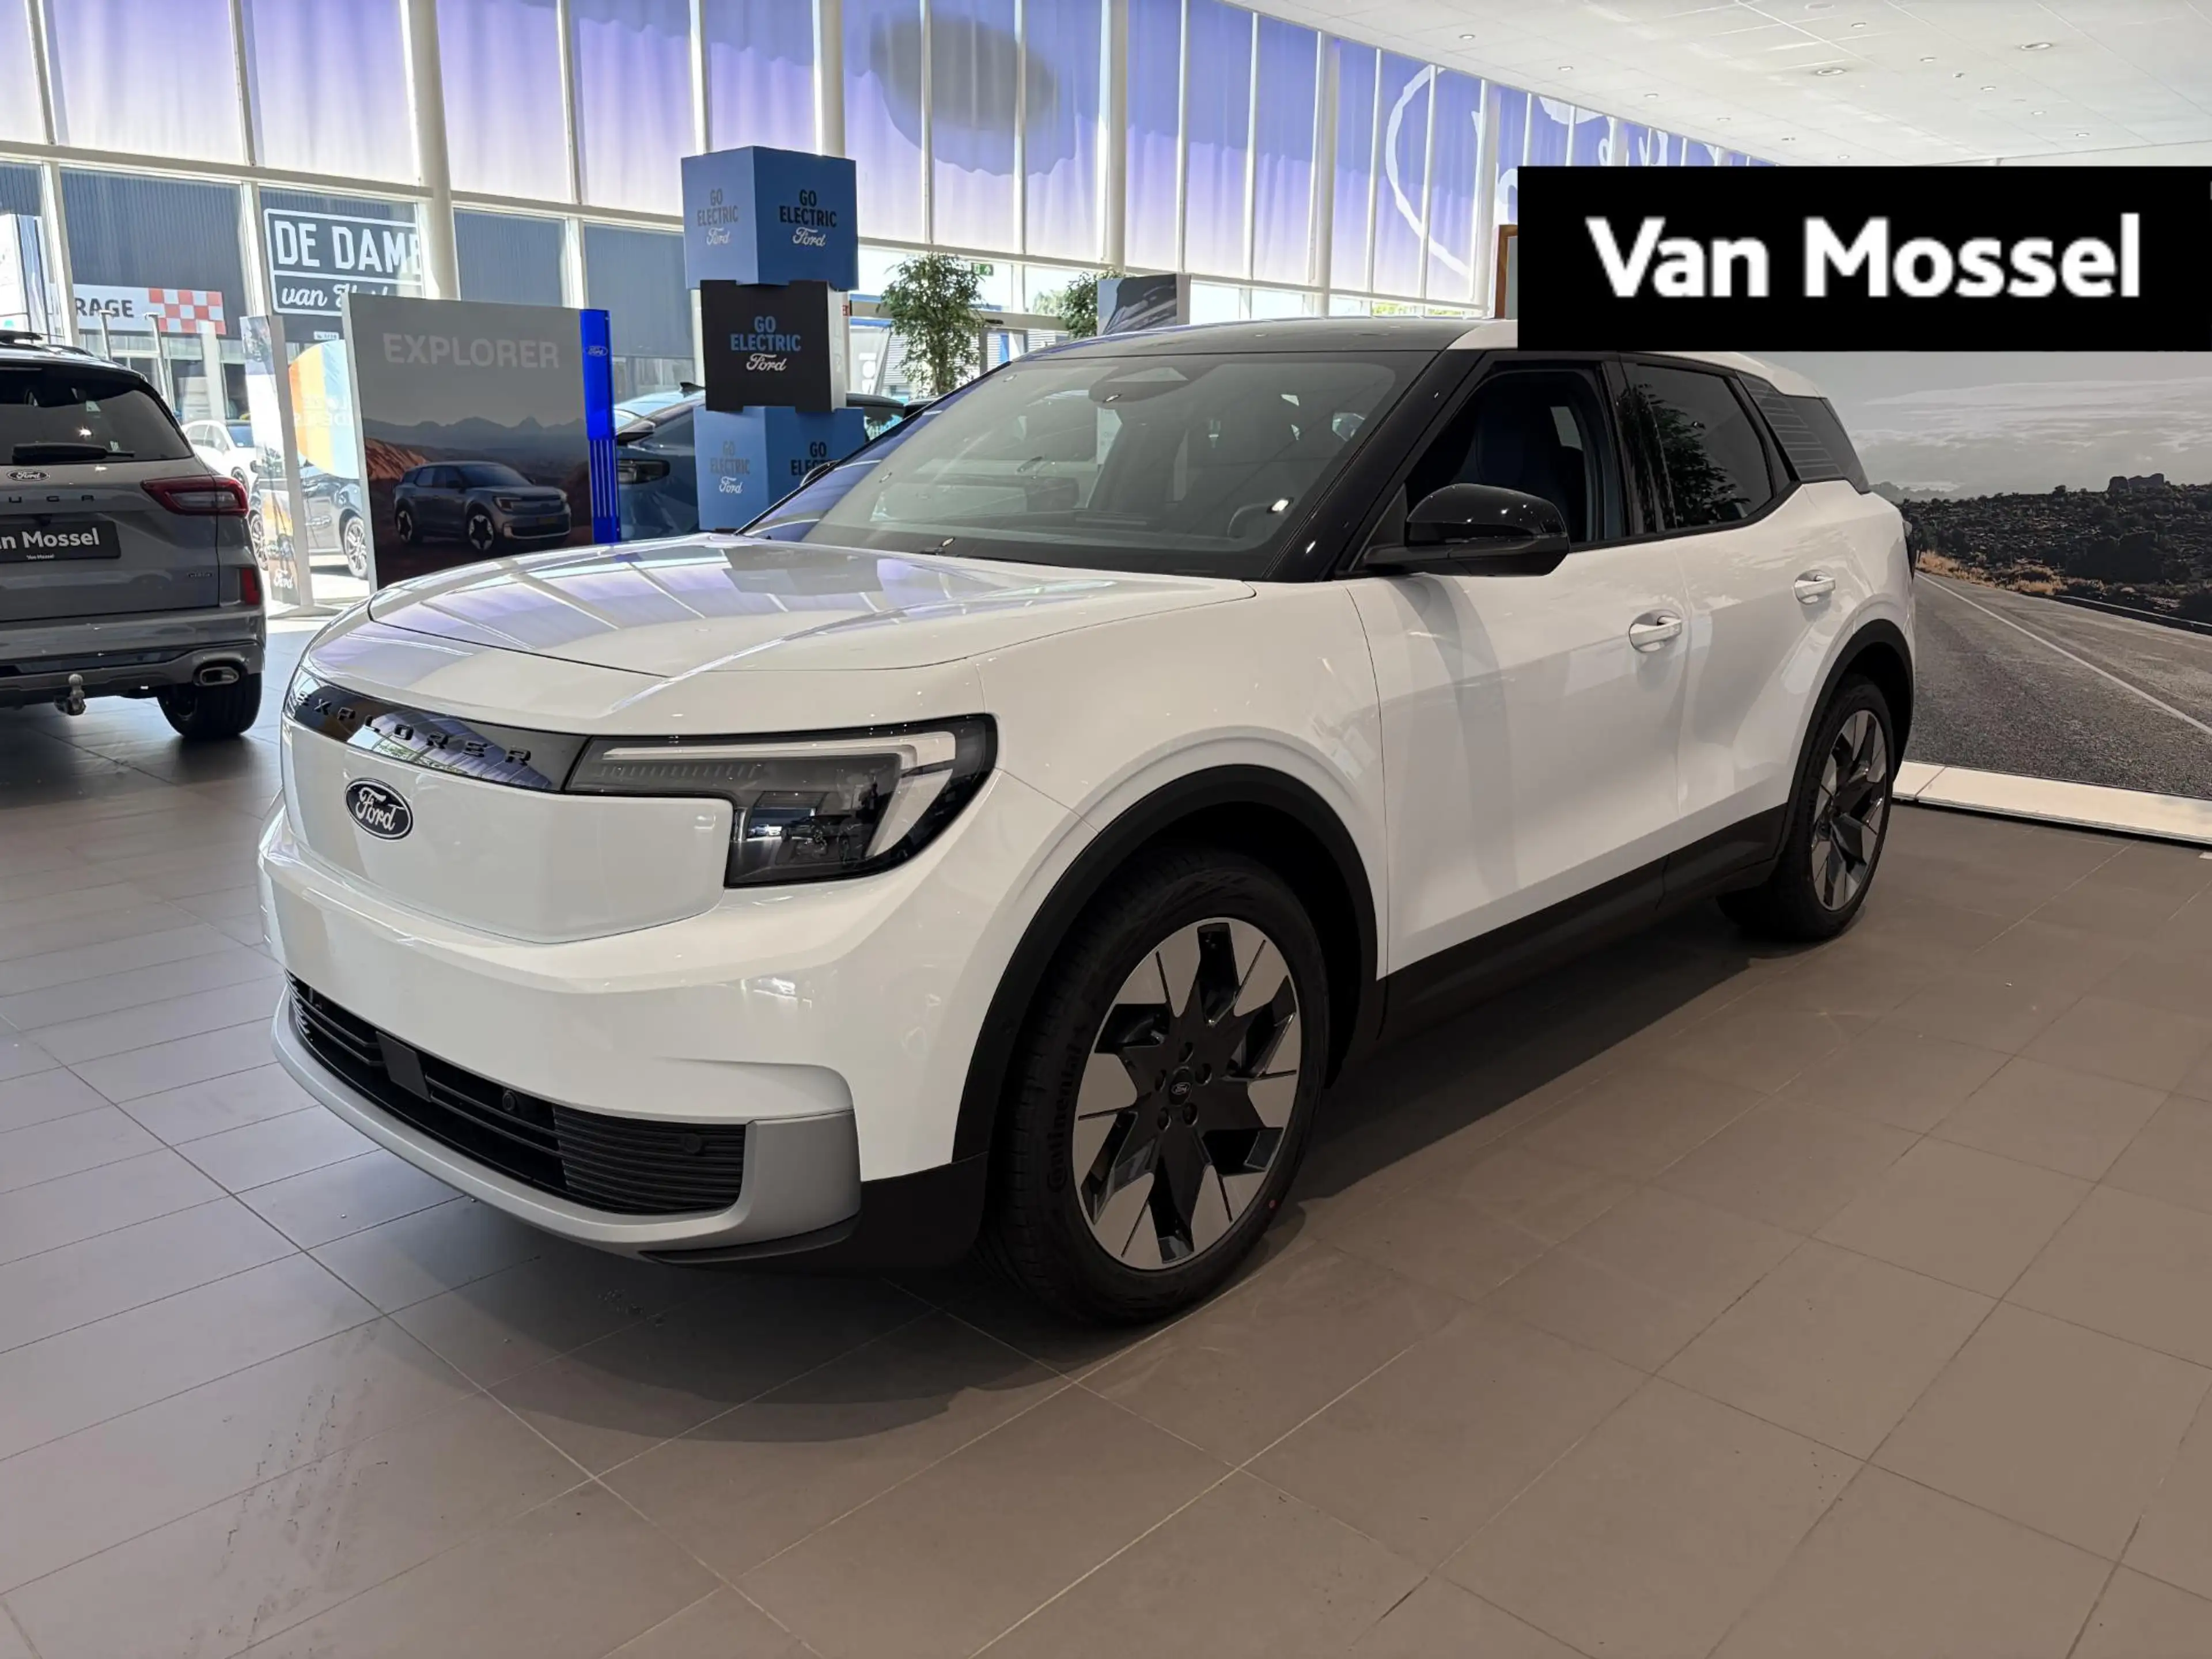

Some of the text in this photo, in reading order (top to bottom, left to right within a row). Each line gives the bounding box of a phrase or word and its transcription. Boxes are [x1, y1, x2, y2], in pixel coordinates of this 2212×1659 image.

[710, 188, 723, 206] GO
[800, 189, 817, 207] GO
[697, 205, 738, 227] ELECTRIC
[779, 205, 837, 228] ELECTRIC
[274, 219, 320, 268] DE
[706, 227, 730, 245] Ford
[793, 226, 827, 247] Ford
[282, 287, 328, 307] van
[754, 316, 777, 333] GO
[382, 333, 560, 369] EXPLORER
[730, 333, 801, 351] ELECTRIC
[745, 353, 787, 371] Ford
[723, 441, 735, 456] GO
[809, 441, 827, 458] GO
[710, 457, 750, 475] ELECTRIC
[719, 476, 744, 494] Ford
[21, 527, 100, 548] Mossel
[296, 691, 532, 767] EXPLORER
